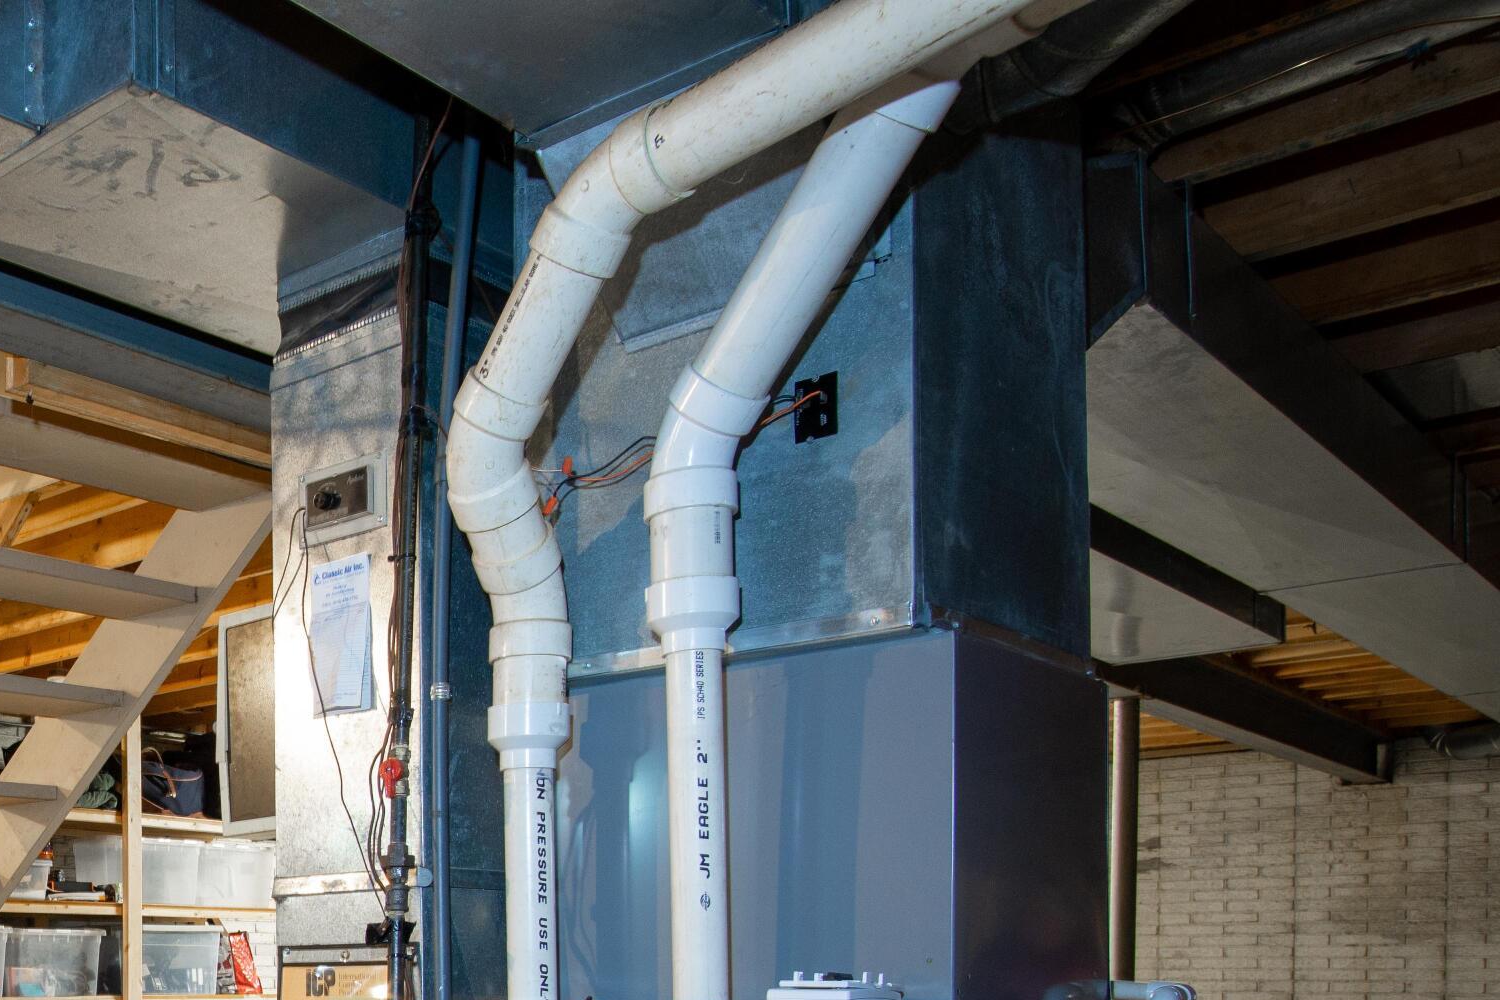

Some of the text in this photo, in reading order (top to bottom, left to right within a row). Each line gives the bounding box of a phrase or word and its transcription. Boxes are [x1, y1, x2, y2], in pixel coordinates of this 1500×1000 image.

[321, 568, 344, 579] Classic
[695, 650, 704, 678] SERIES
[697, 777, 709, 840] EAGLE
[536, 811, 548, 905] PRESSURE
[699, 853, 711, 879] JM
[539, 917, 549, 951] USE
